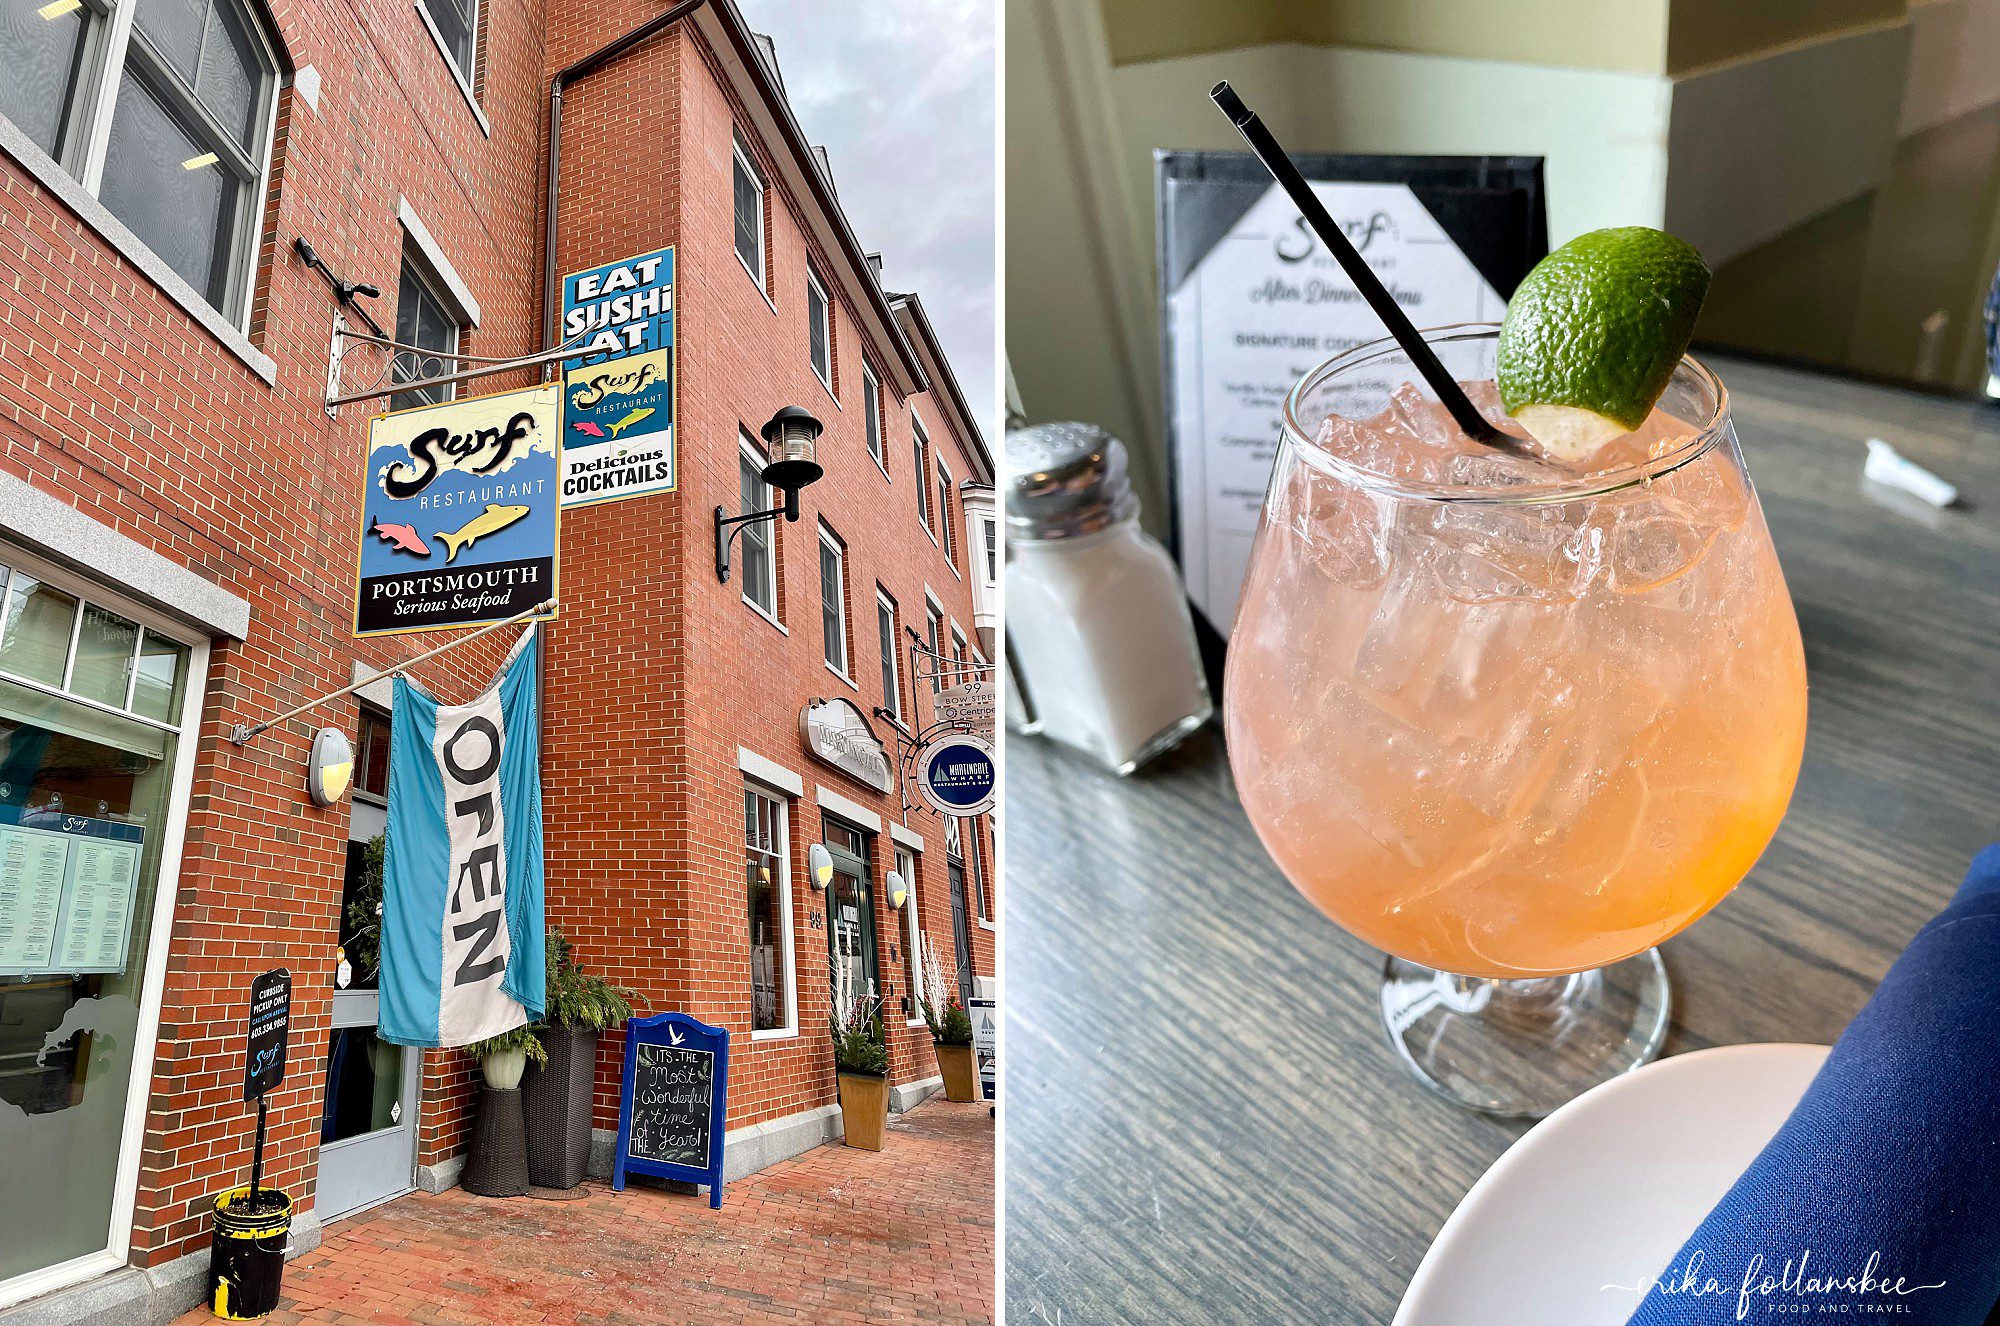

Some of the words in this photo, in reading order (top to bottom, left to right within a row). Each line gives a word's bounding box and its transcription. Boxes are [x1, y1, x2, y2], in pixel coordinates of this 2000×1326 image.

[576, 256, 663, 302] EAT
[577, 364, 656, 409] Surf
[596, 394, 663, 414] RESTAURANT
[385, 412, 536, 498] Surf
[570, 448, 664, 475] Delicious
[564, 461, 668, 496] COCKTAILS
[420, 479, 545, 509] RESTAURANT
[372, 566, 539, 600] PORTSMOUTH
[394, 599, 447, 615] Serious
[451, 589, 512, 614] Seafood
[965, 683, 981, 694] 99
[949, 763, 989, 775] MARTINGALE
[443, 716, 506, 987] OPEN
[254, 1000, 273, 1014] PICKUP
[274, 994, 288, 1007] ONLY
[259, 983, 285, 1000] CURBSIDE
[678, 1052, 698, 1063] THE
[637, 1119, 649, 1138] of
[631, 1138, 651, 1153] THE
